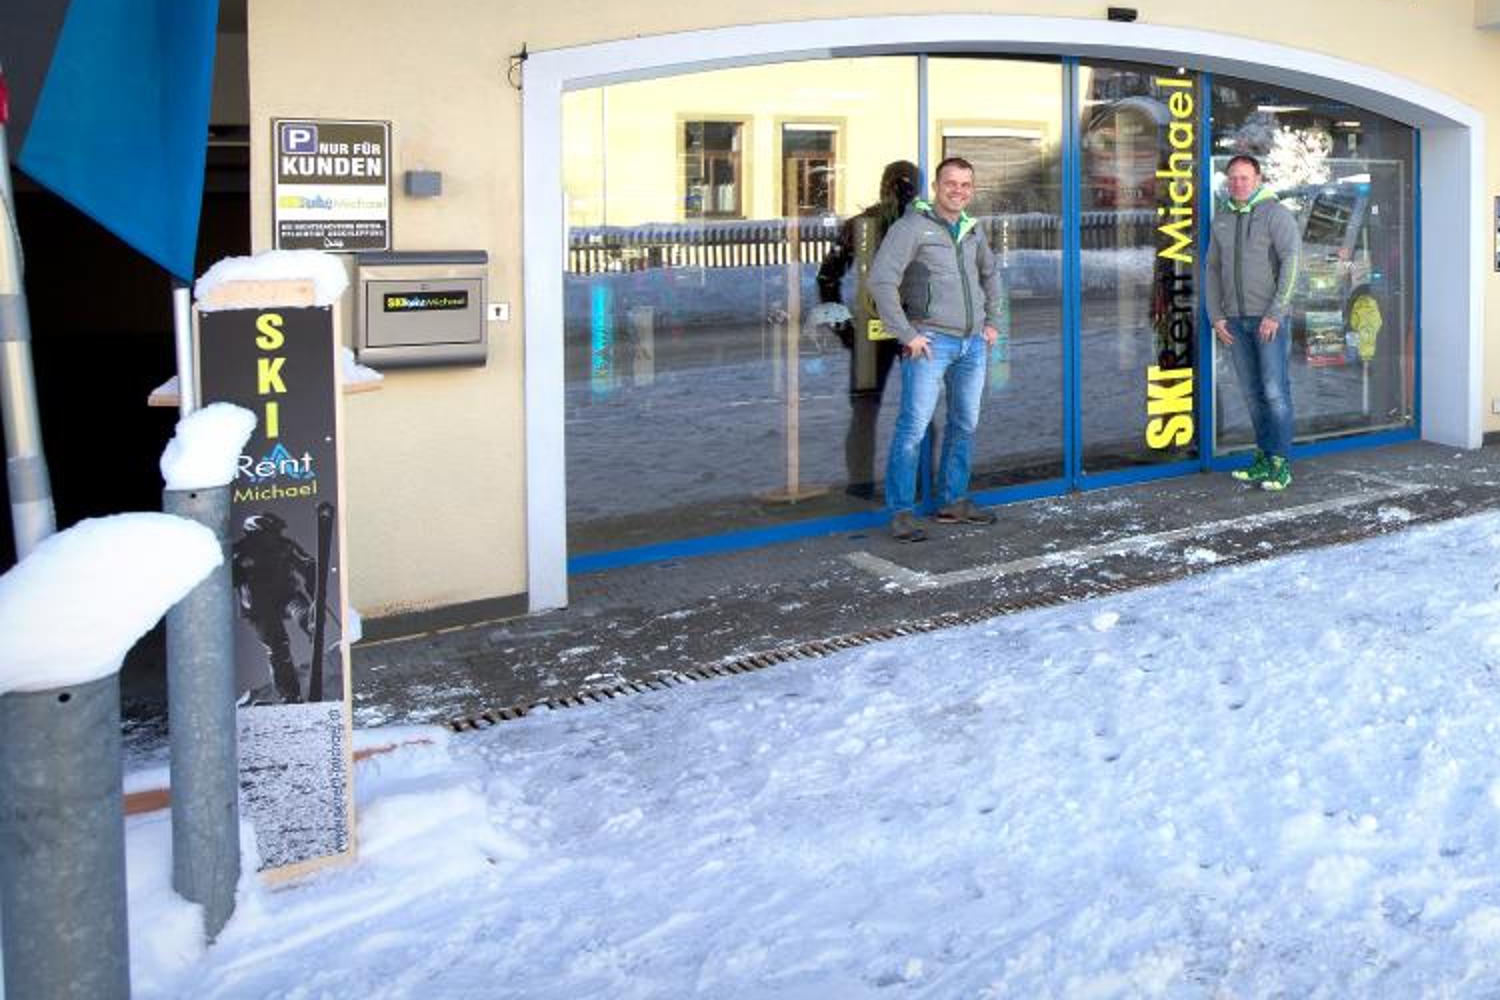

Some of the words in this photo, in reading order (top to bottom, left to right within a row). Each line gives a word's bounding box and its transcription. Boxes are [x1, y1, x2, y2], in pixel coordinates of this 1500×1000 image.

[319, 143, 349, 155] NUR
[353, 141, 381, 155] FÜR
[281, 157, 382, 177] KUNDEN
[1155, 77, 1194, 263] Michael
[235, 451, 314, 478] Rent
[233, 480, 318, 503] Michael
